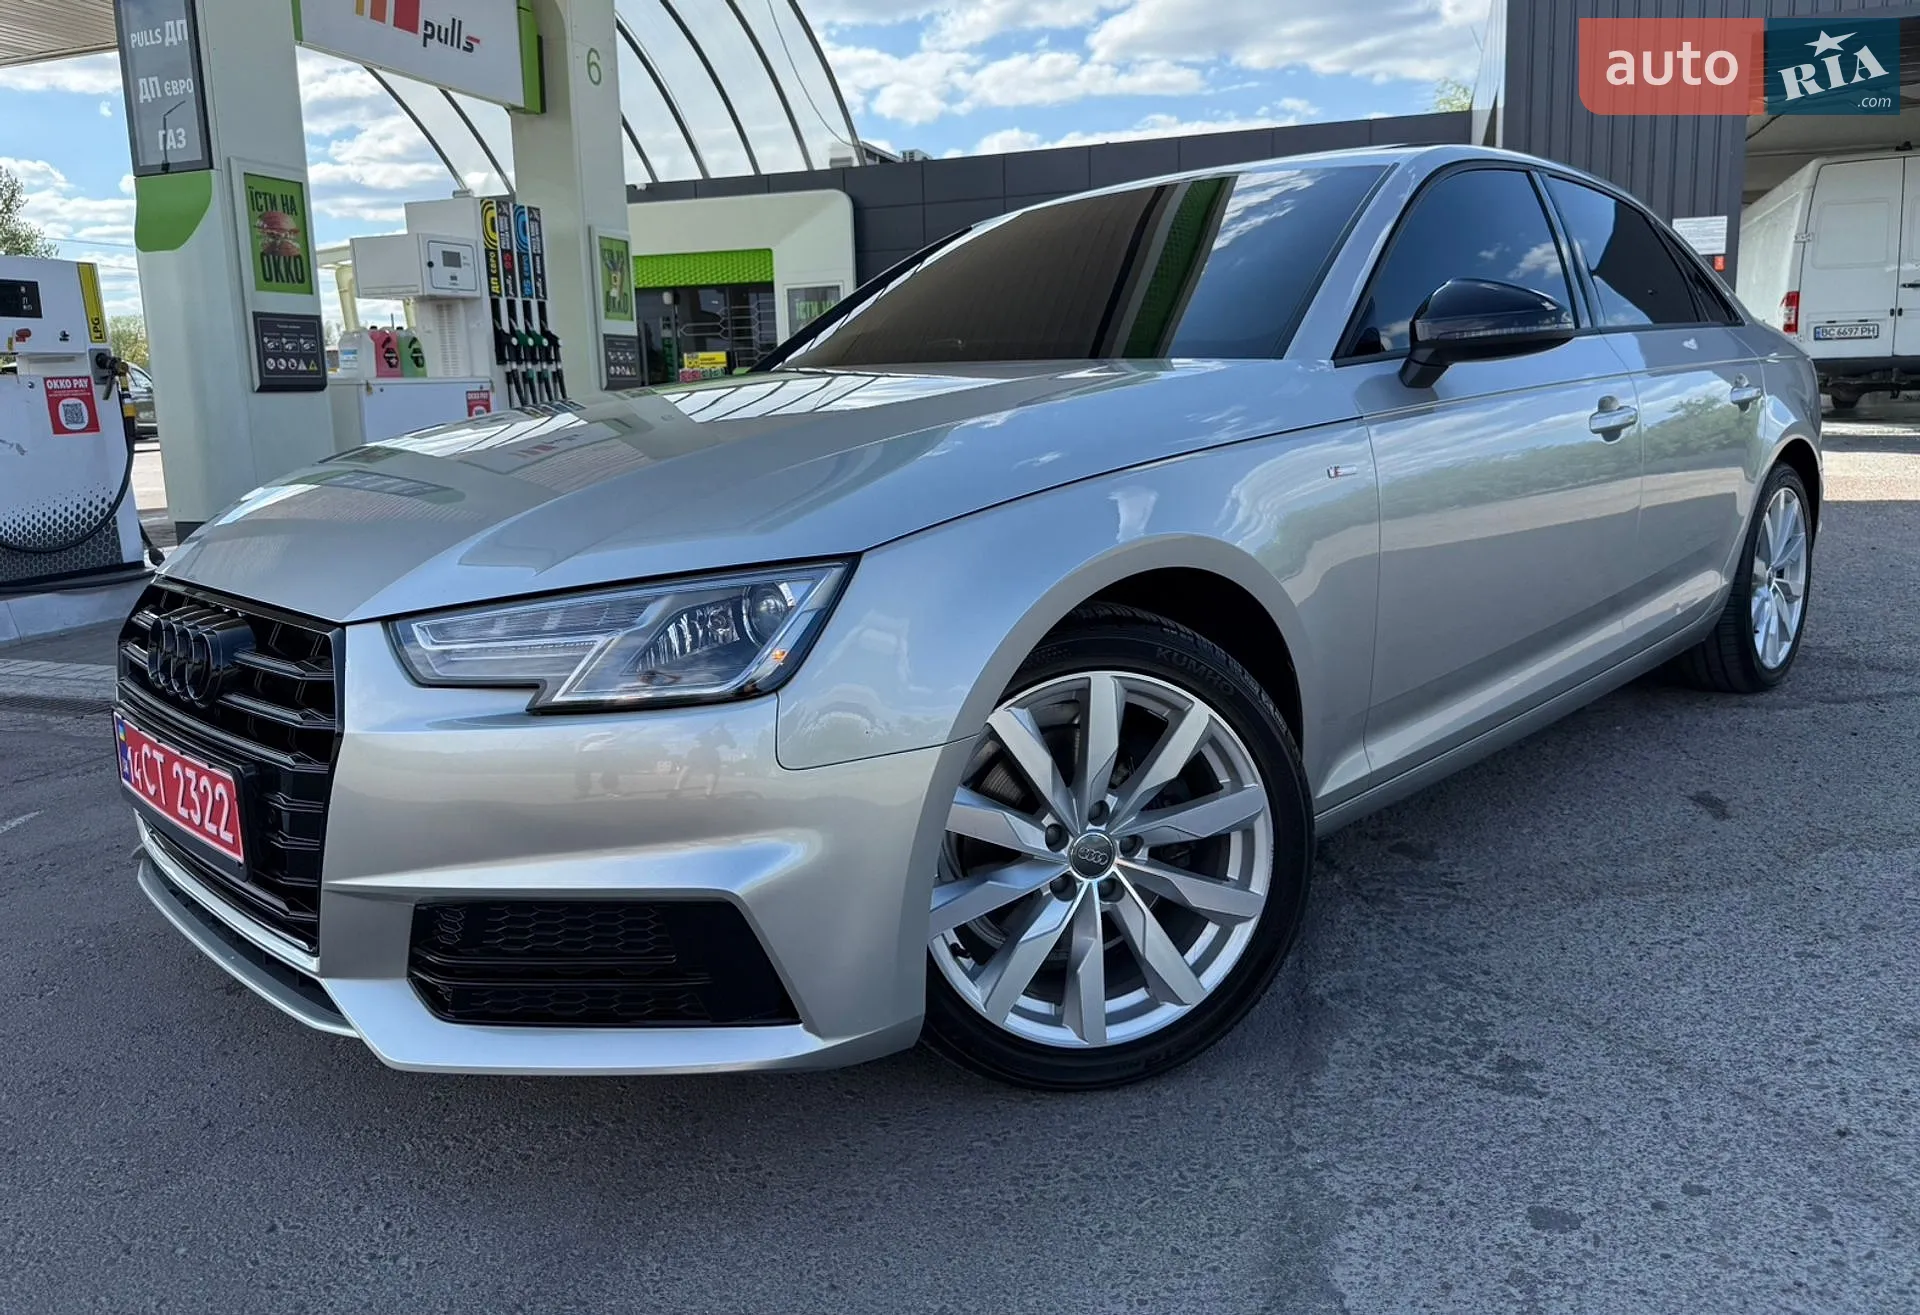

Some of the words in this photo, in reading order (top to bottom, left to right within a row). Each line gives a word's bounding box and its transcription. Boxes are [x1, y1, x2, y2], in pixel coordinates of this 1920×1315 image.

[130, 28, 162, 49] PULLS
[164, 19, 189, 46] ДП
[423, 18, 481, 53] pulls
[586, 47, 602, 86] 6
[138, 76, 162, 103] ДП
[164, 77, 194, 97] ЄВРО
[158, 127, 187, 151] ГАЗ
[248, 186, 278, 214] ЇСТИ
[281, 193, 298, 216] НА
[91, 317, 104, 340] LPG
[46, 378, 72, 390] OKKO
[73, 378, 89, 389] PAY
[172, 761, 234, 844] 2322
